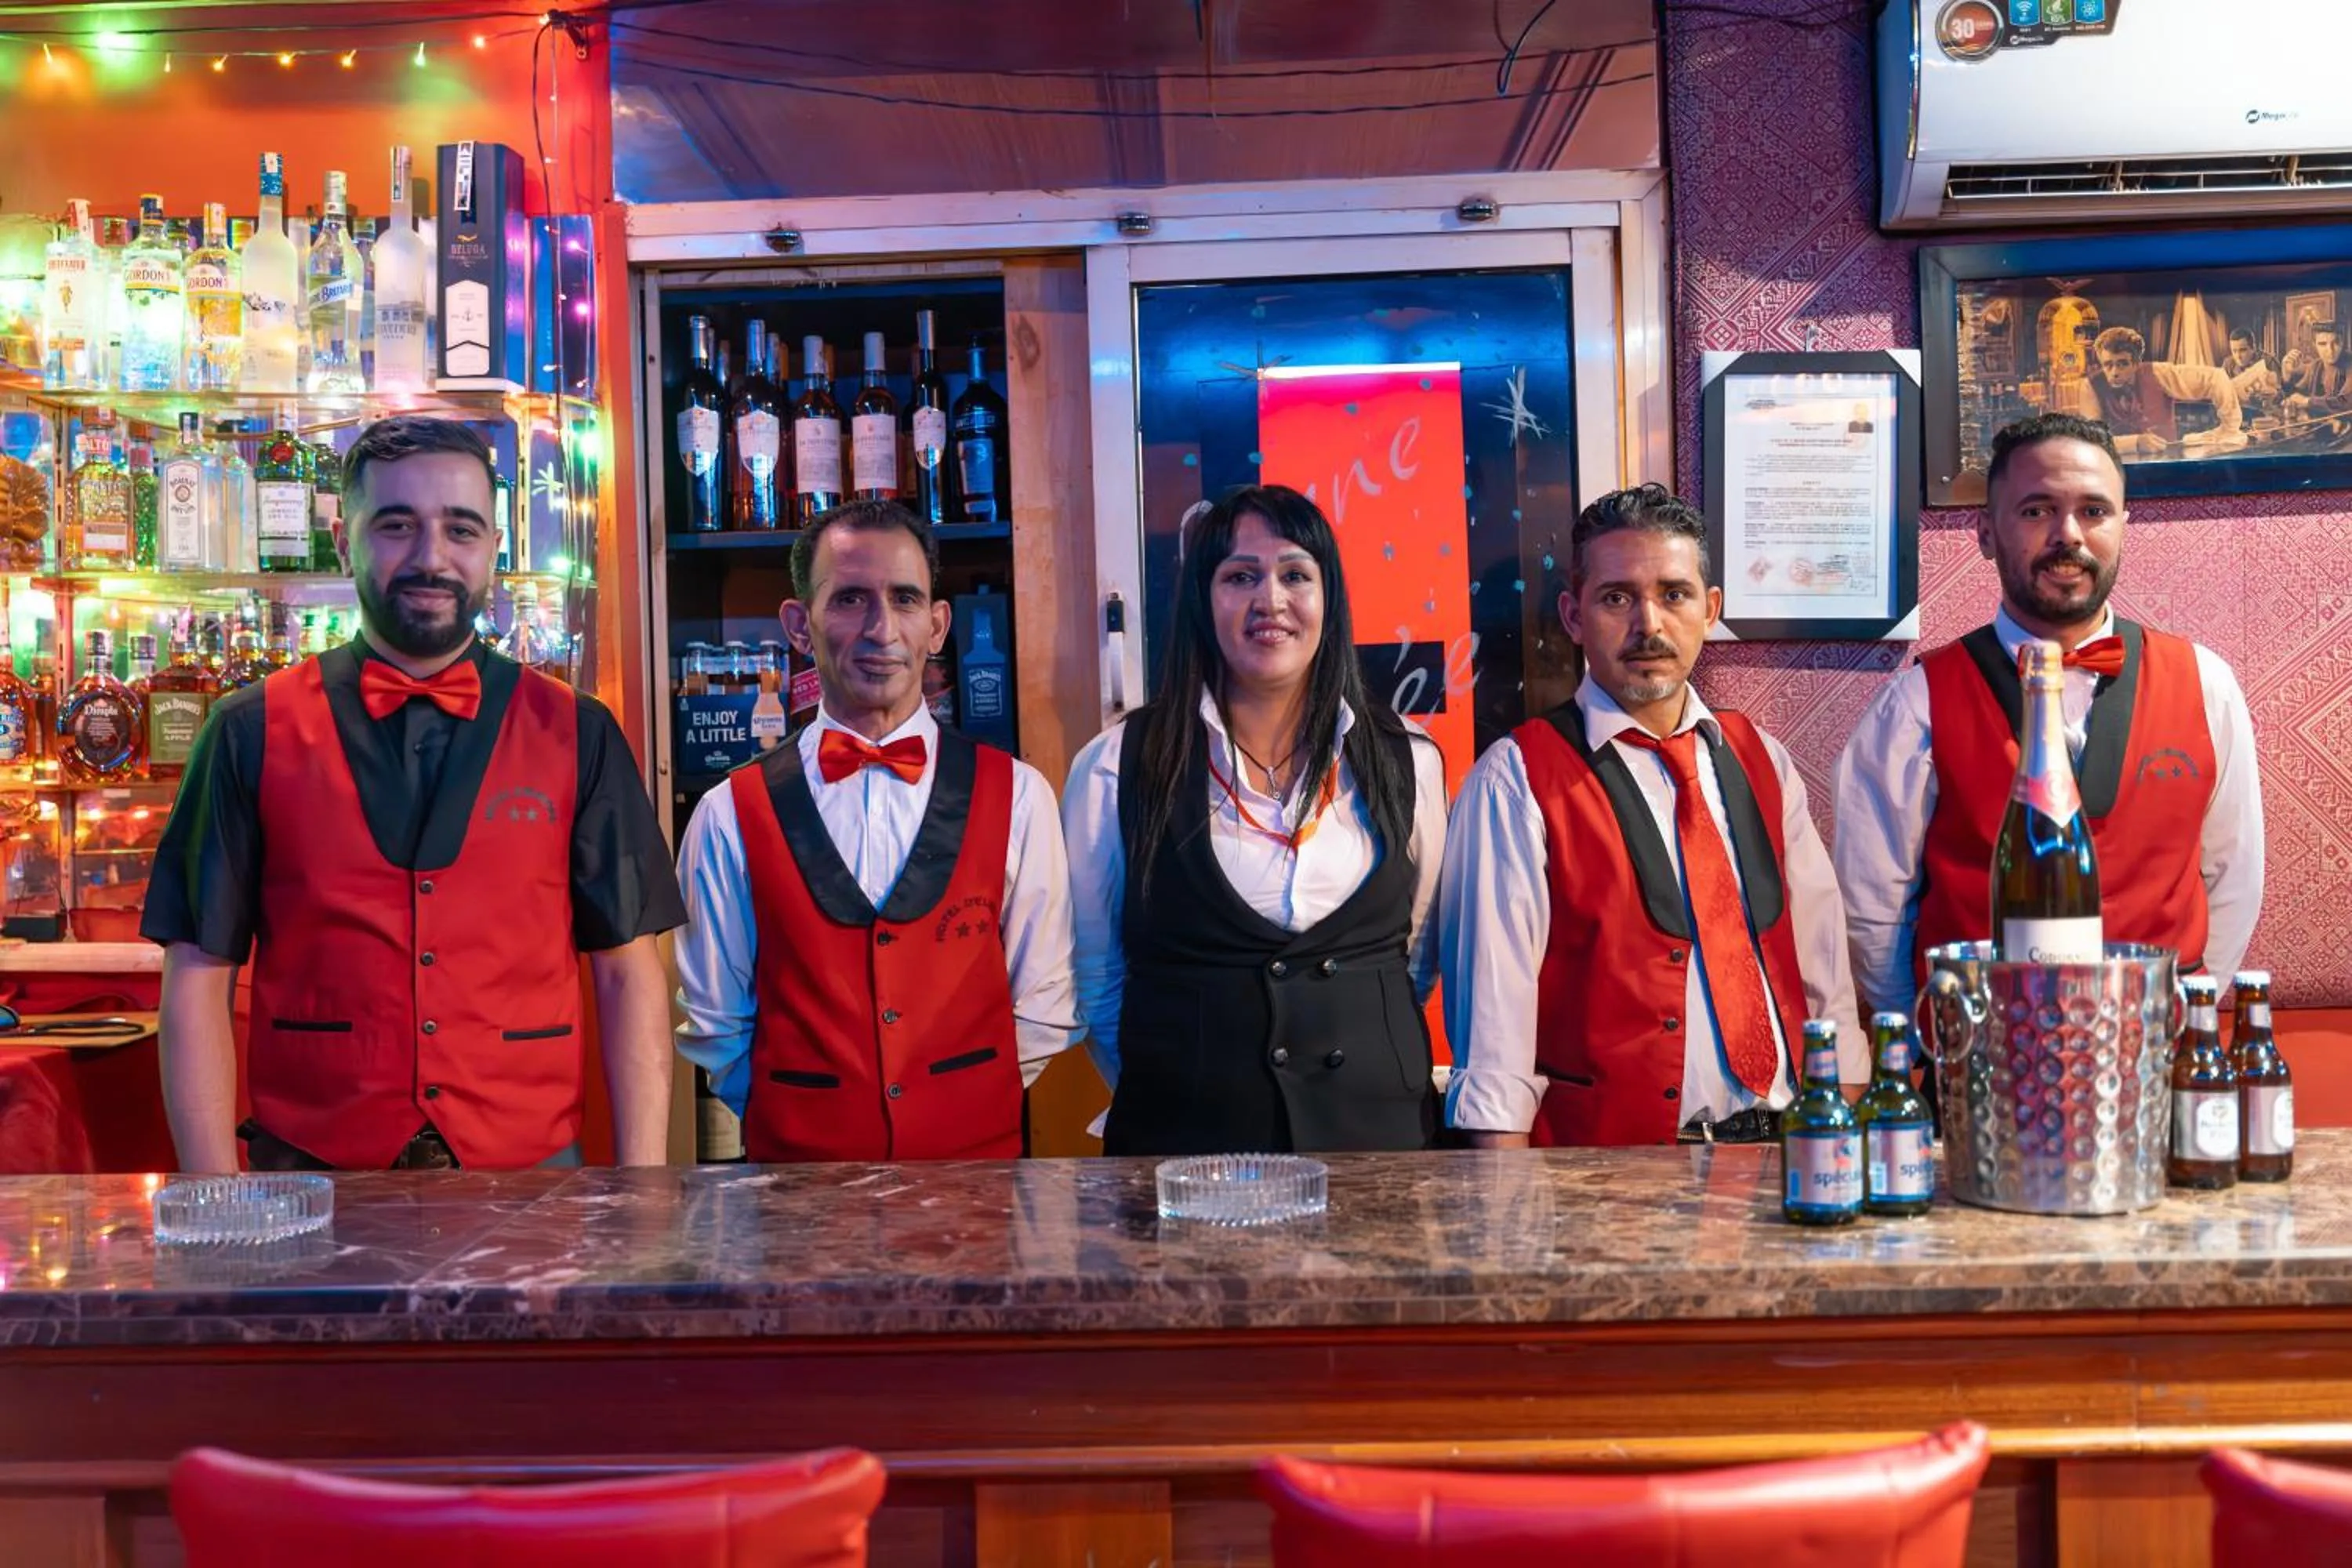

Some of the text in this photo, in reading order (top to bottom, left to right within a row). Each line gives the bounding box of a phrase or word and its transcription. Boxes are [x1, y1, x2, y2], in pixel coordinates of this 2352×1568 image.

[1951, 19, 1975, 38] 30
[692, 711, 739, 726] ENJOY
[685, 728, 746, 744] A LITTLE
